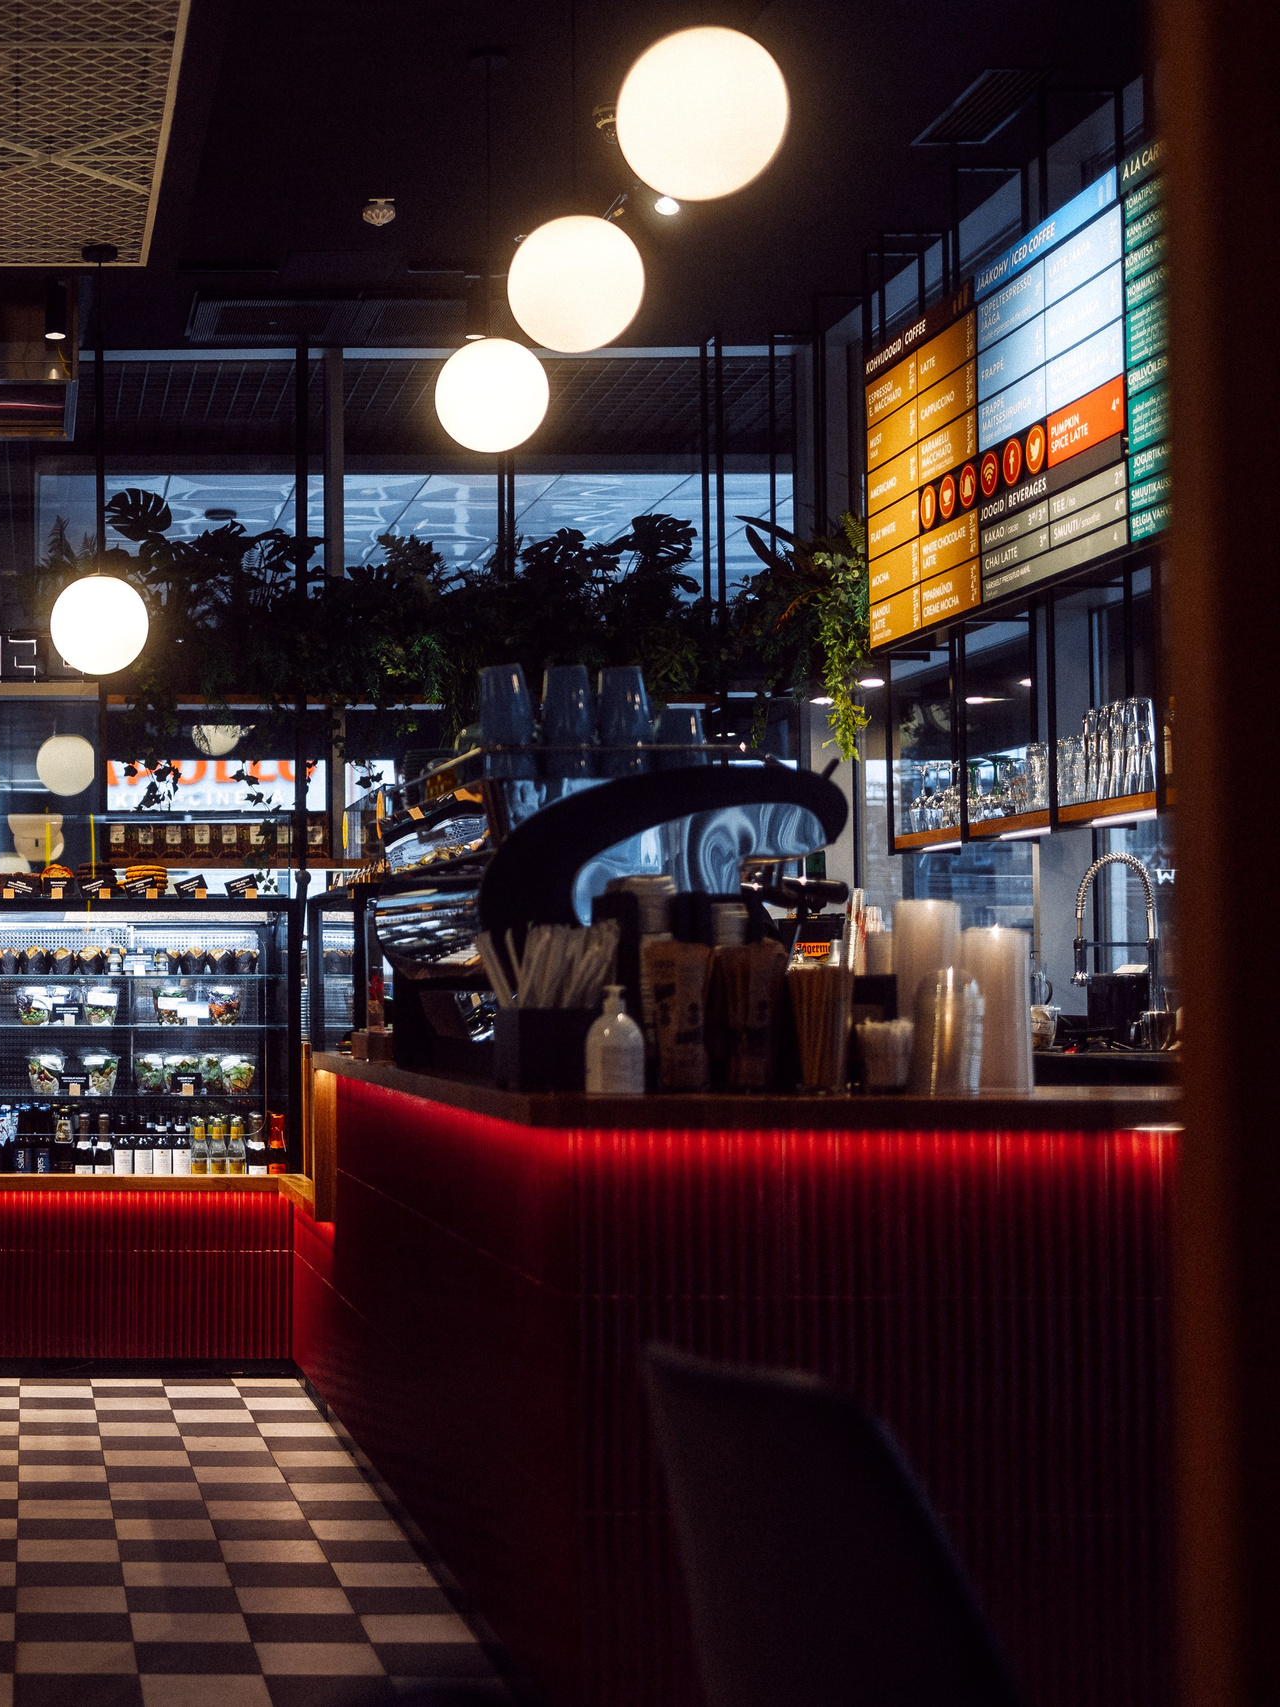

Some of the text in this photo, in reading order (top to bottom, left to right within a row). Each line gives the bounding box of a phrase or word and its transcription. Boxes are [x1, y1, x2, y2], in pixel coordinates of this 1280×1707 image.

[1130, 156, 1140, 176] LA
[976, 257, 1008, 292] JÄÄKOHV
[1011, 244, 1028, 267] ICED
[1028, 221, 1056, 254] COFFEE
[980, 274, 1032, 318] TOPELTESPRESSO
[904, 319, 926, 346] COFFEE
[920, 356, 936, 374] LATTE
[981, 356, 1004, 382] FRAPPÉ
[920, 390, 955, 420] CAPPUCCINO
[1050, 412, 1080, 439] PUMPKIN
[921, 430, 950, 455] KARAMELLI
[1051, 422, 1088, 454] SPICE LATTE
[922, 443, 952, 468] MACCHIATO
[870, 476, 897, 500] AMERICANO
[980, 499, 1005, 522] JOOGID
[1008, 477, 1047, 508] BEVERAGES
[1053, 498, 1065, 514] TEE
[870, 522, 896, 543] FLAT WHITE
[922, 540, 937, 555] WHITE
[938, 526, 966, 549] CHOCOLATE
[984, 526, 1005, 544] KAKAO
[1053, 518, 1078, 540] SMUUTI
[922, 554, 936, 570] LATTE
[985, 546, 1018, 570] CHAI LATTE
[872, 571, 890, 588] MOCHA
[940, 594, 960, 613] MOCHA
[872, 618, 886, 632] LATTE
